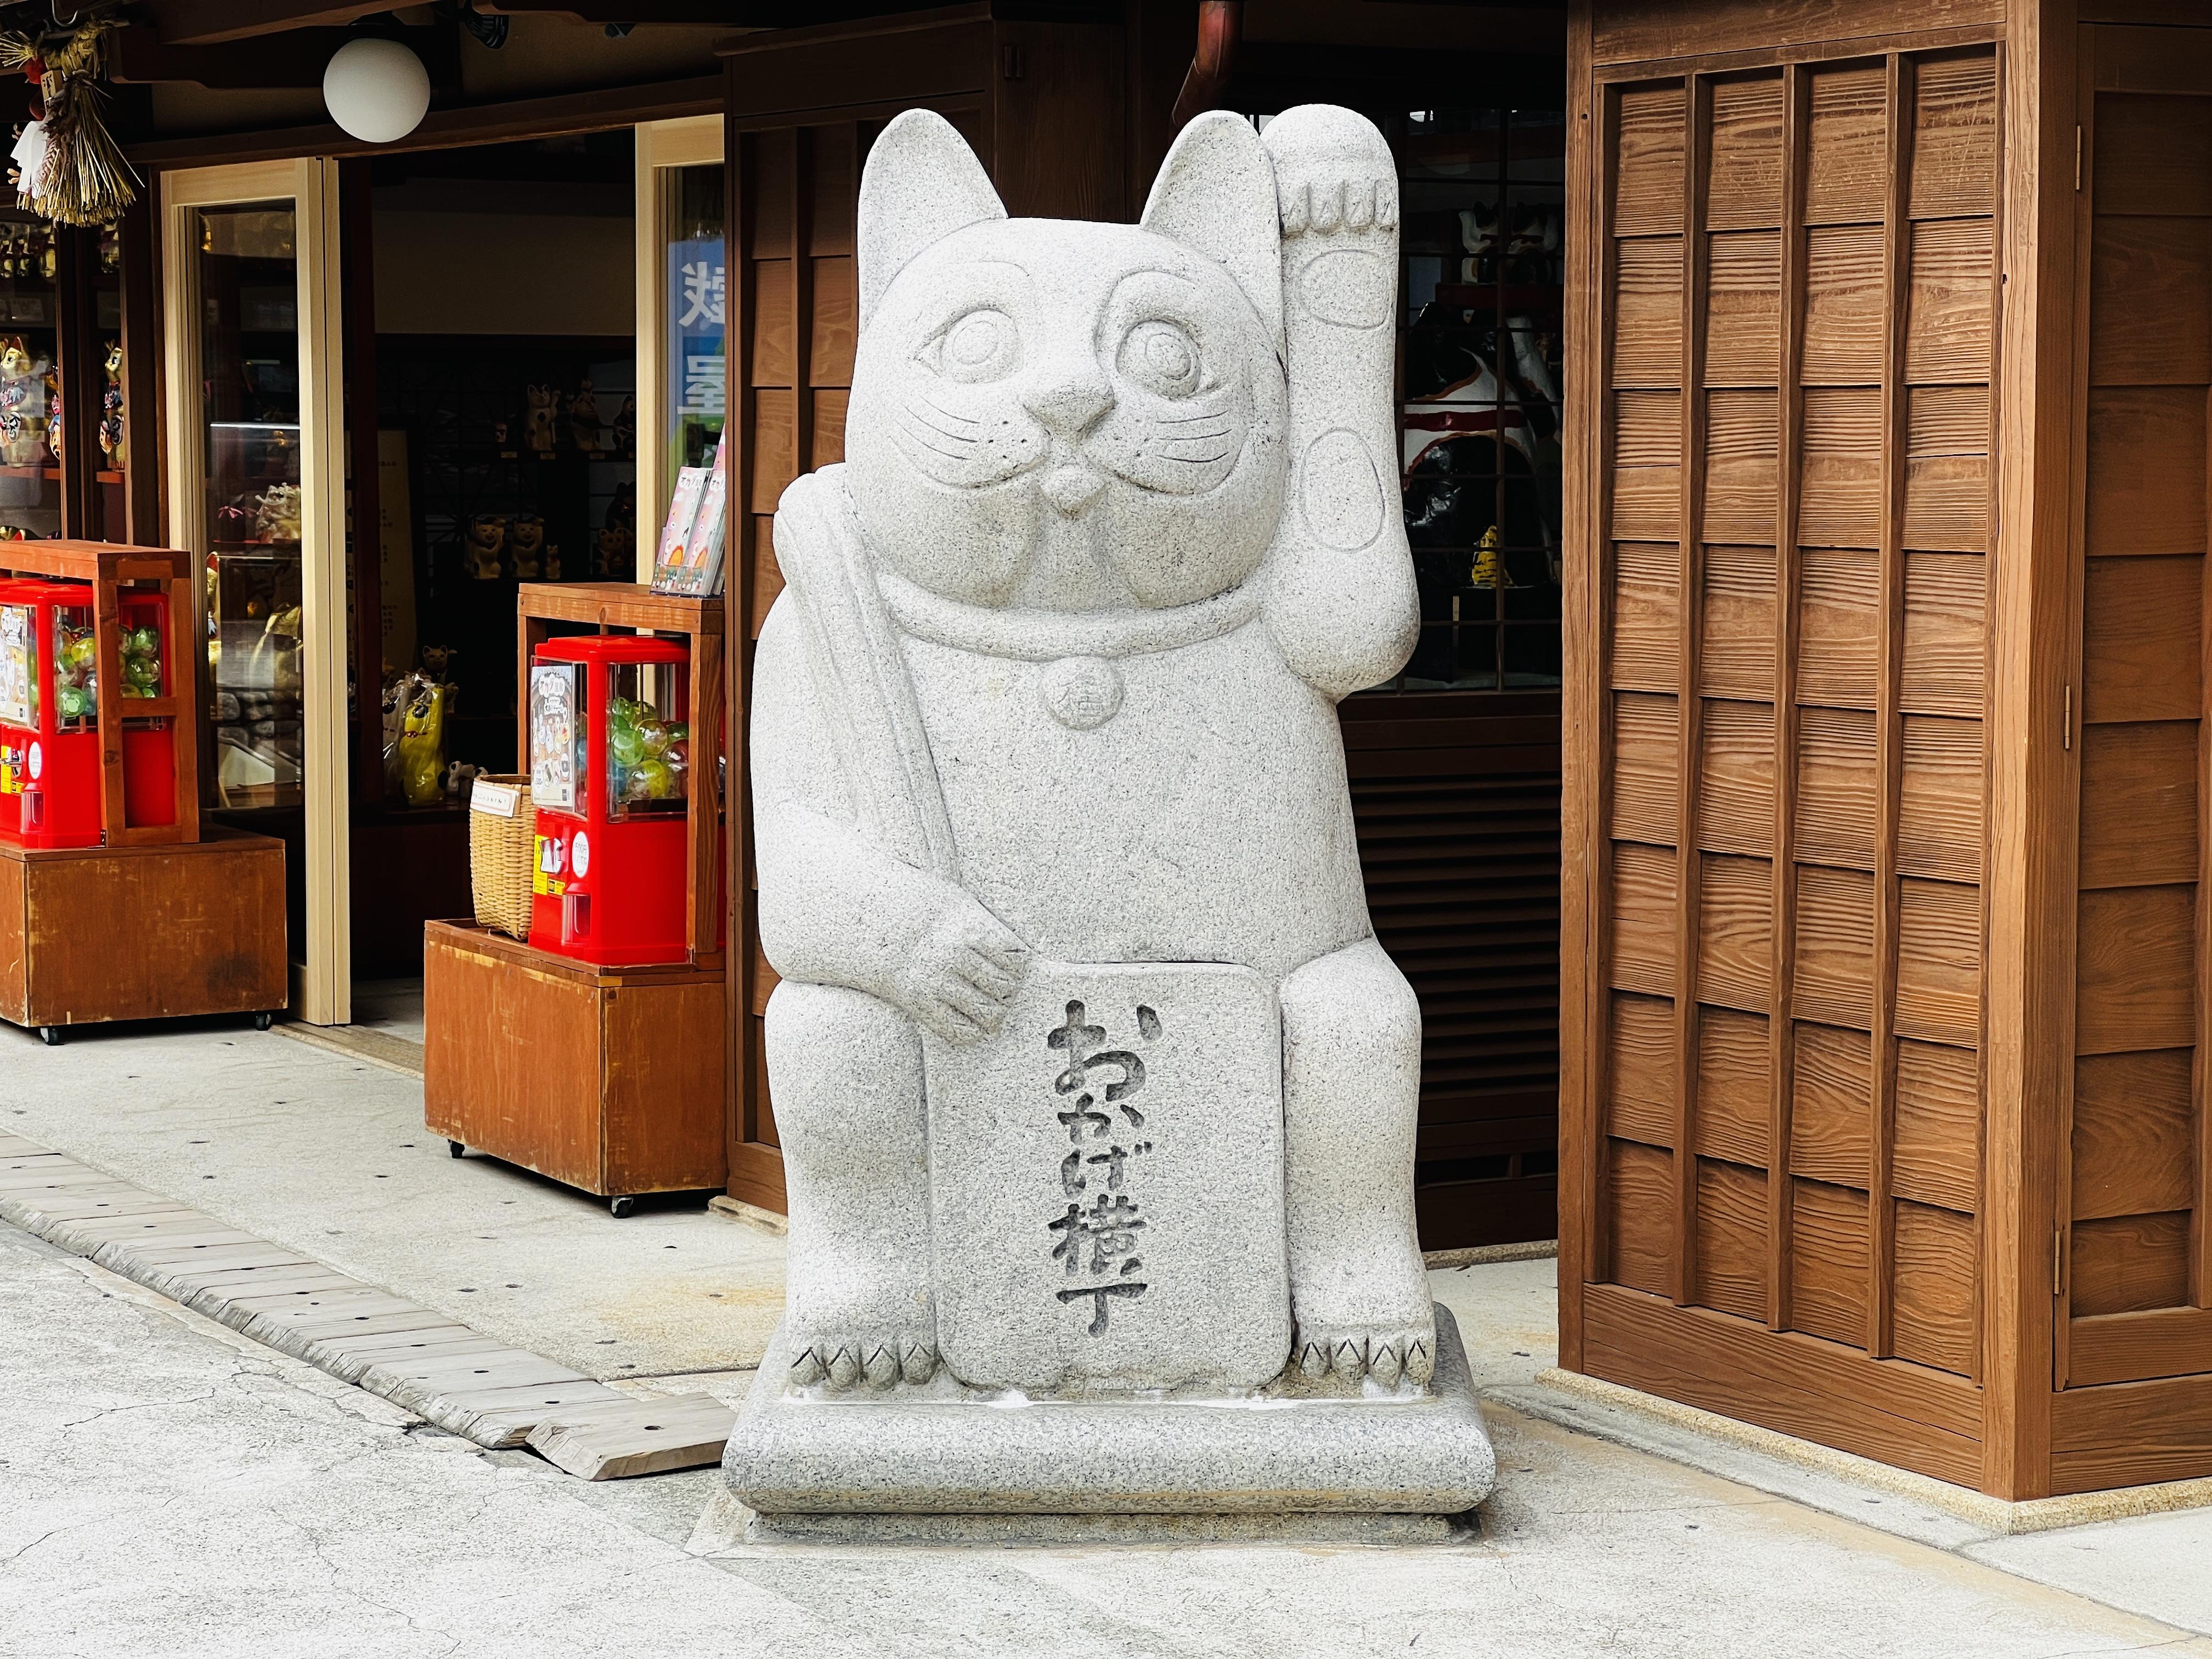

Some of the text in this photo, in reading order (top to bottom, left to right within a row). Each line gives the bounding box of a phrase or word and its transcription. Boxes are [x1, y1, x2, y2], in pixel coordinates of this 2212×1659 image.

[1047, 999, 1163, 1338] おかげ横丁
